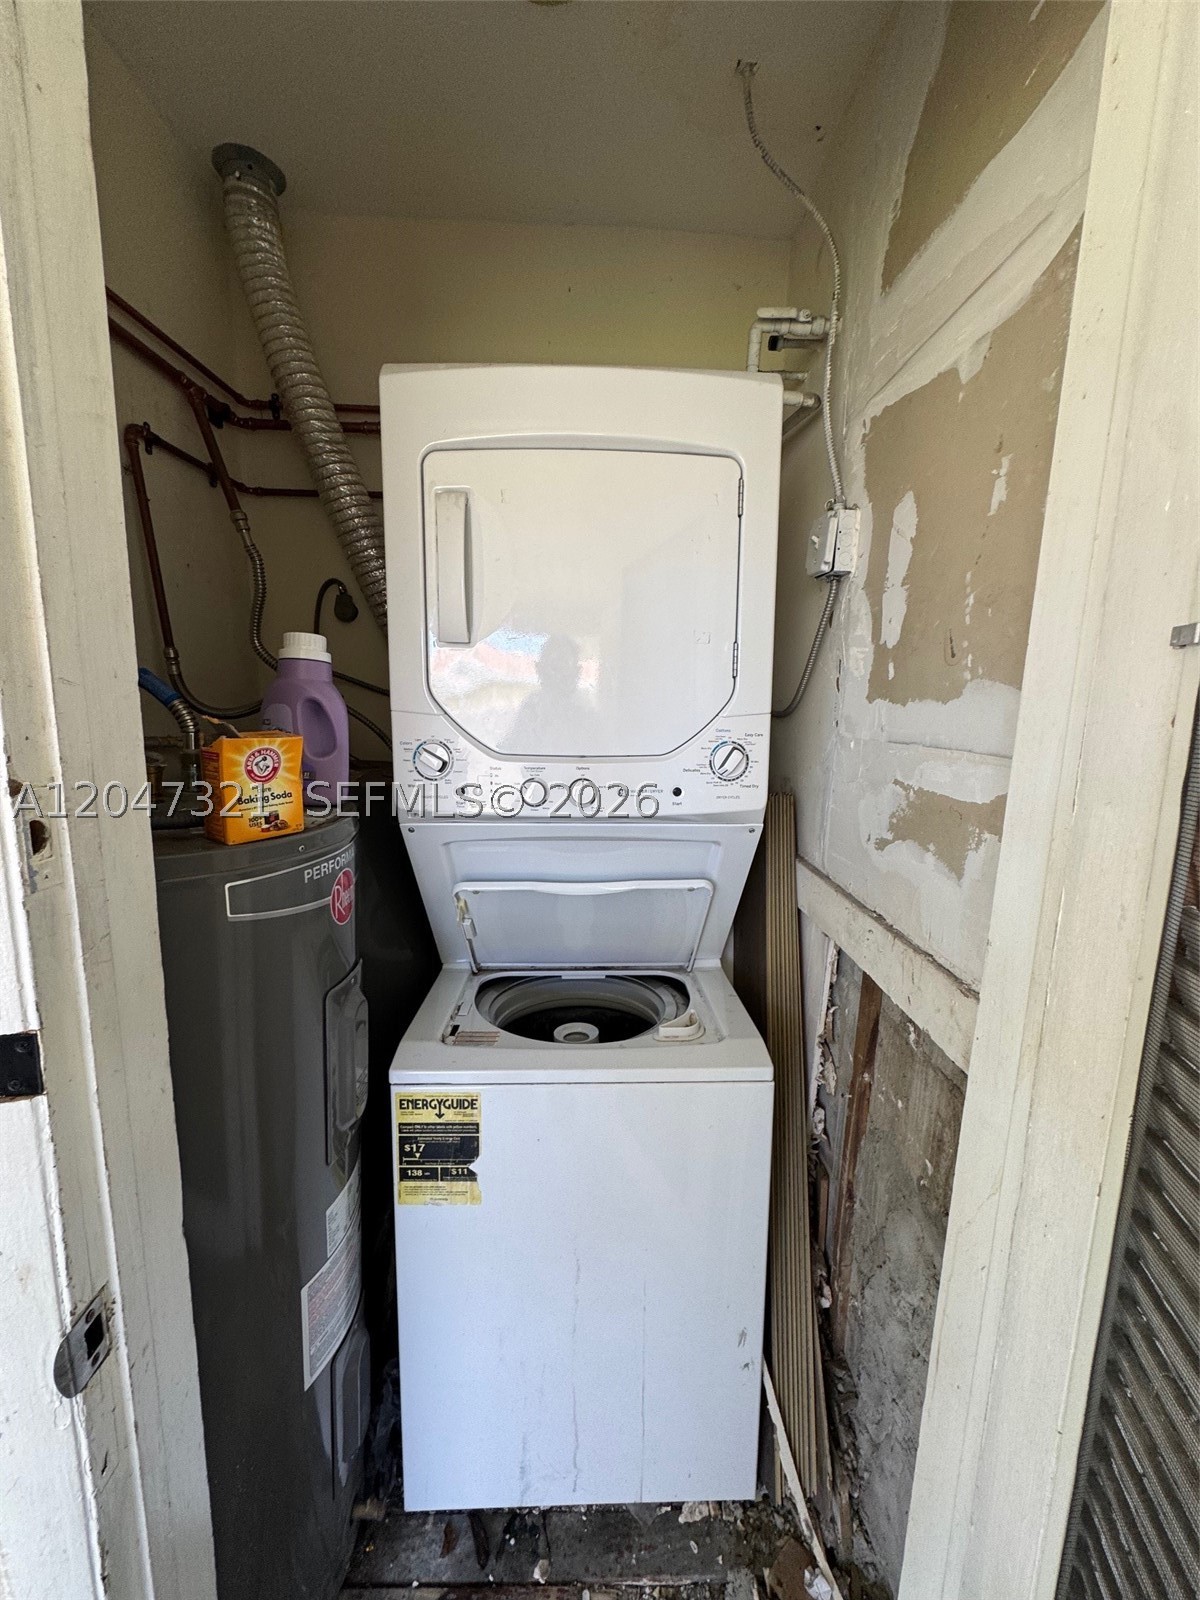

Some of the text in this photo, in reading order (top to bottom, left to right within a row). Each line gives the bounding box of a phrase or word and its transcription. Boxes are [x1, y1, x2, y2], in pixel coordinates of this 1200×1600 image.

[271, 791, 292, 801] Soda
[399, 1099, 478, 1110] ENERGYGUIDE
[404, 1143, 426, 1152] $17
[407, 1169, 423, 1177] 138
